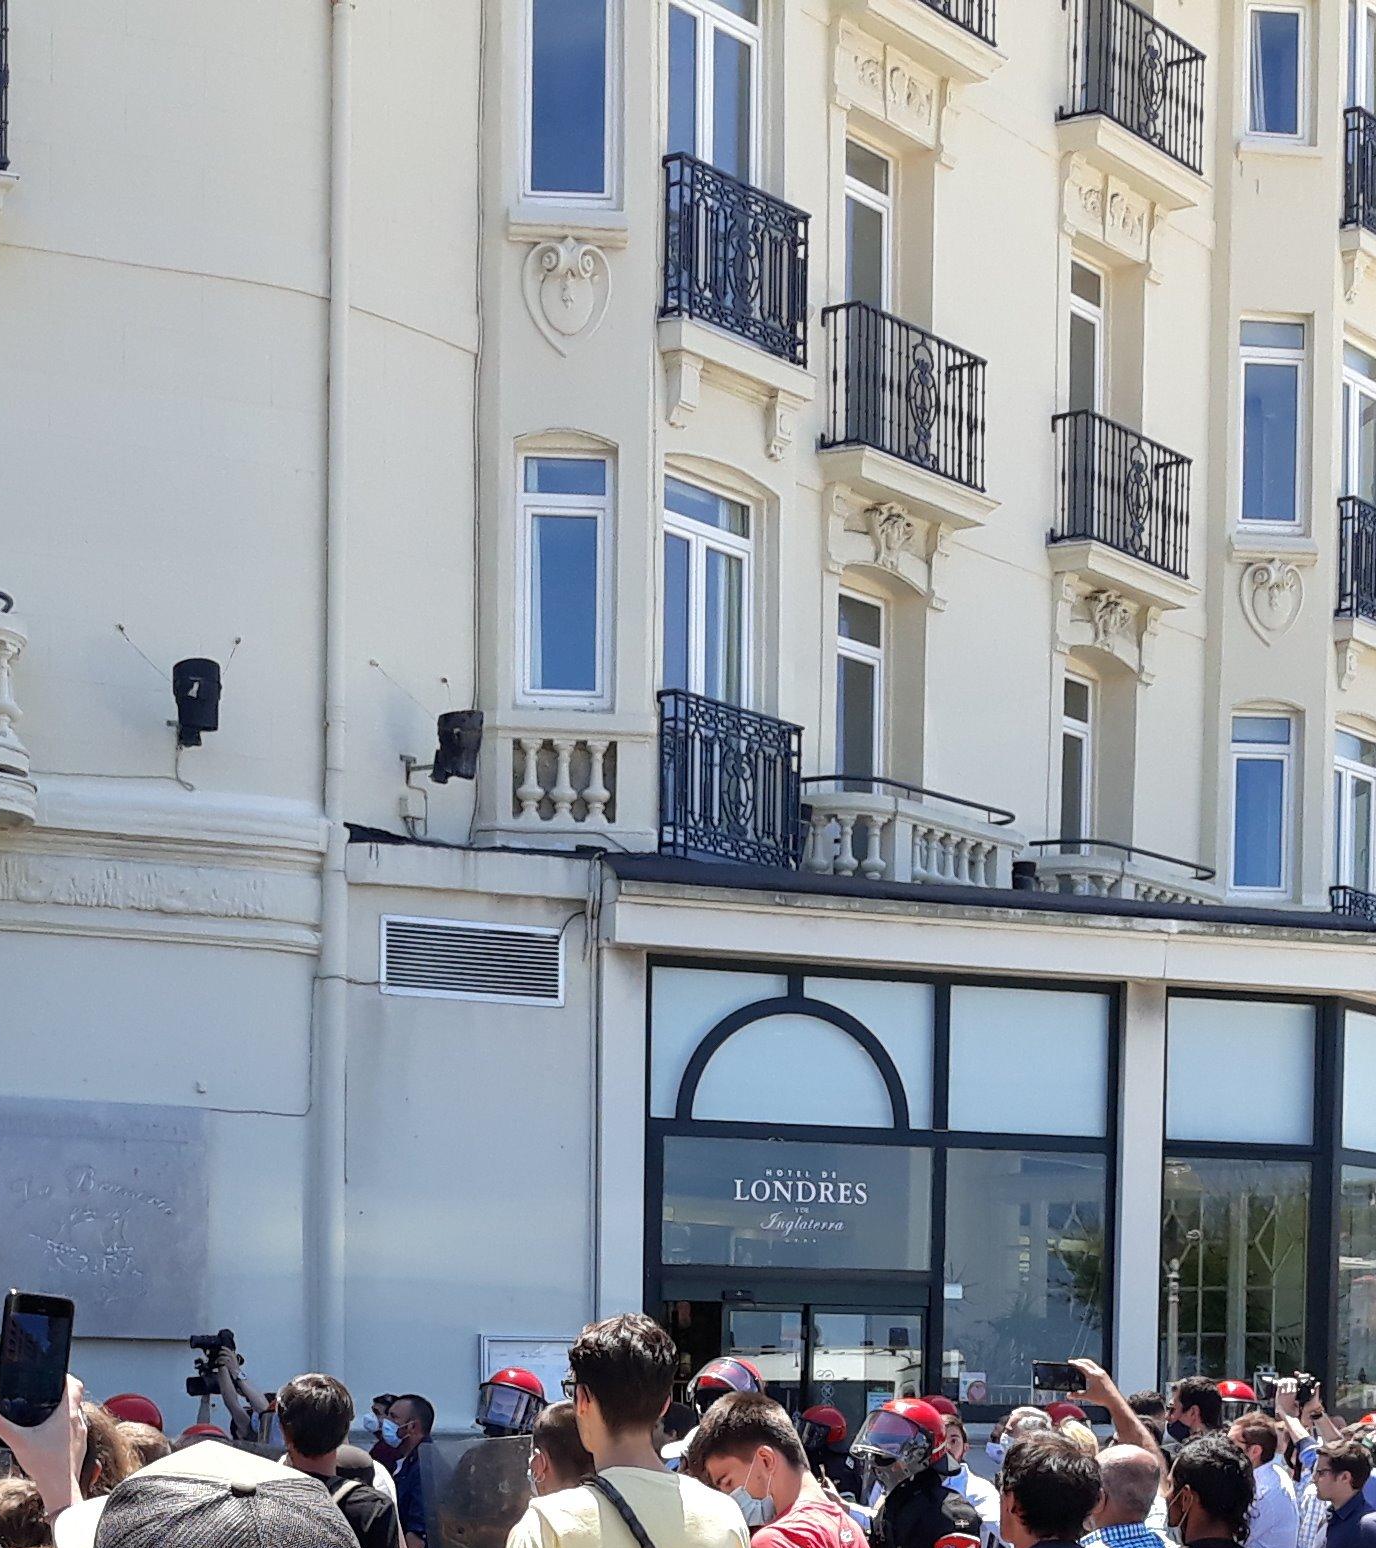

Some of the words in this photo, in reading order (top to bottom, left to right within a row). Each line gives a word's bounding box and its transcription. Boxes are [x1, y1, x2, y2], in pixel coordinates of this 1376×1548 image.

[765, 1168, 811, 1178] HOTEL
[821, 1170, 837, 1179] DE
[733, 1178, 868, 1205] LONDRES
[760, 1210, 845, 1236] Inglaterra
